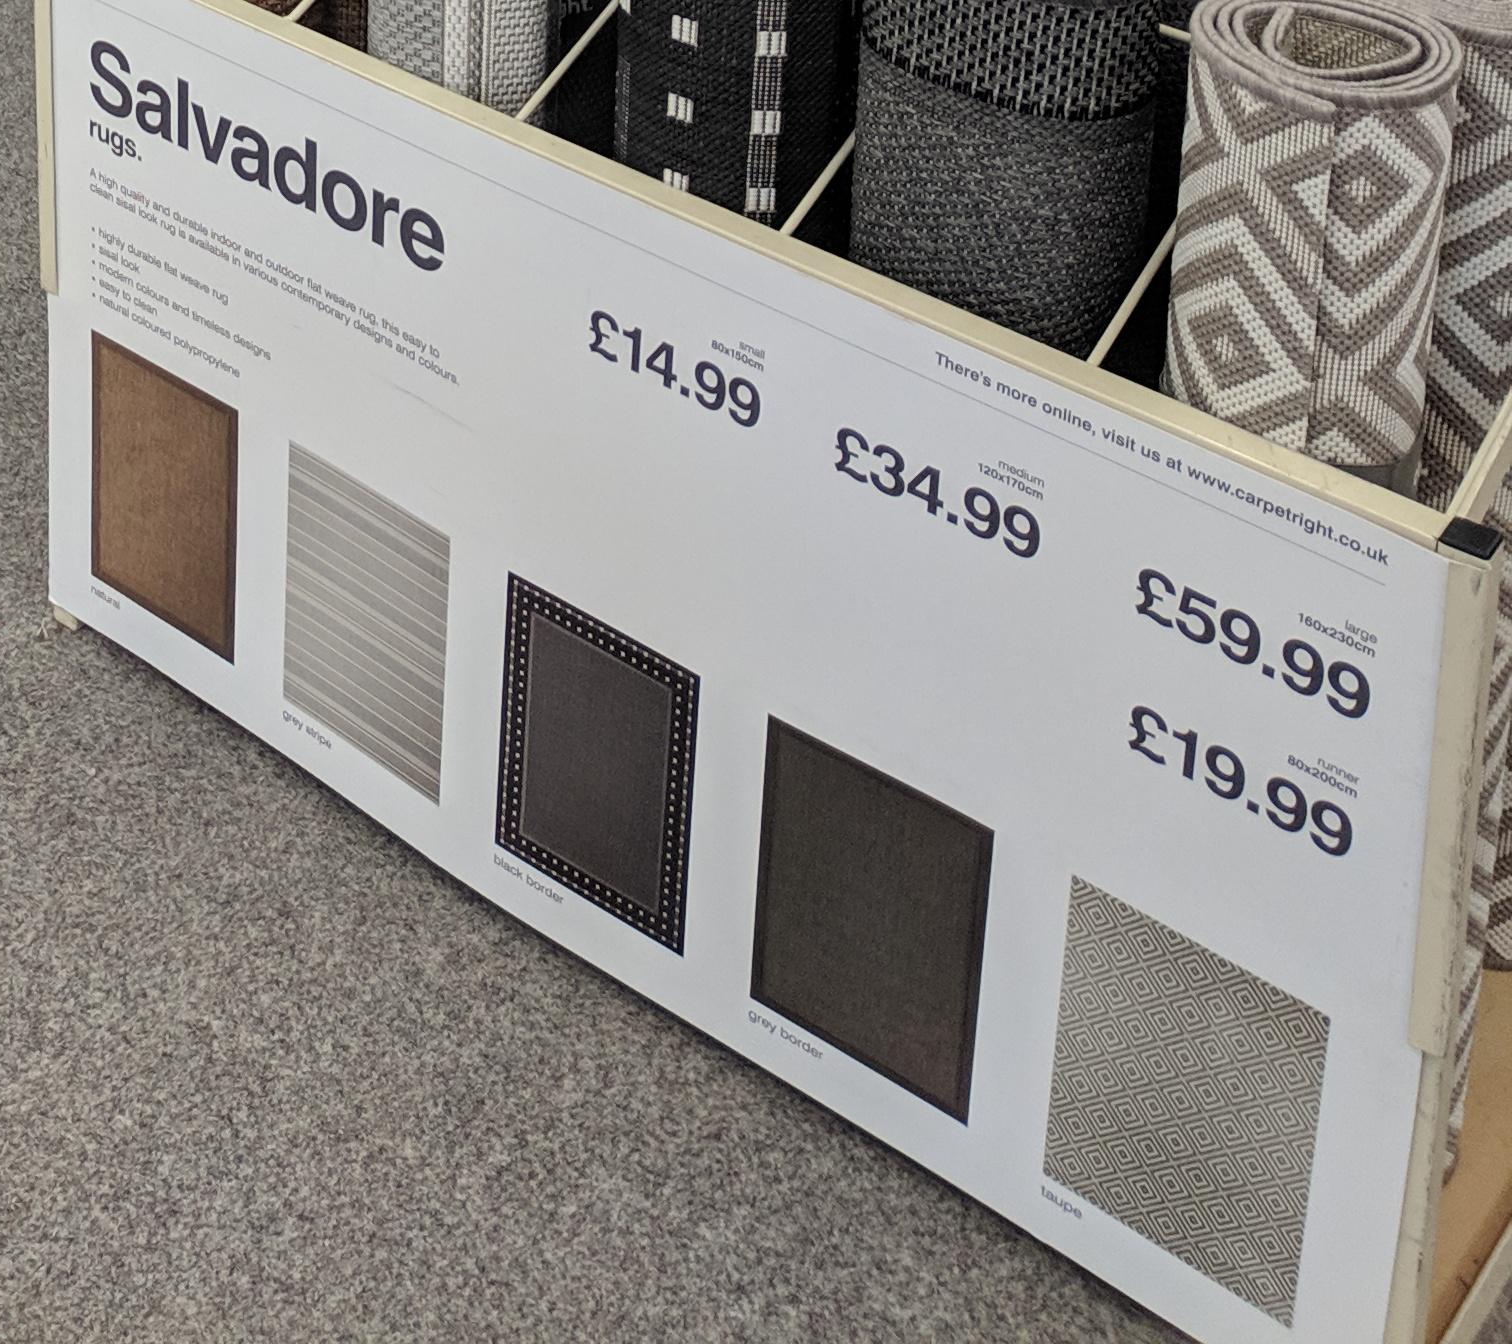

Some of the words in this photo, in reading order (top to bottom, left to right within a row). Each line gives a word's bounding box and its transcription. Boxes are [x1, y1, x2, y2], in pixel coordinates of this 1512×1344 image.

[89, 119, 142, 162] rugs.
[89, 40, 446, 272] Salvadore
[89, 167, 97, 179] A
[99, 172, 119, 190] high
[120, 185, 150, 208] quality
[152, 202, 170, 217] and
[173, 207, 209, 236] durable
[210, 229, 242, 252] indoor
[243, 248, 264, 265] and
[266, 255, 304, 286] outdoor
[307, 278, 322, 294] flat
[324, 288, 357, 313] weave
[381, 317, 400, 336] this
[402, 331, 427, 353] easy
[429, 345, 440, 358] to
[90, 183, 114, 202] clean
[115, 197, 136, 213] sisal
[138, 207, 158, 225] look
[160, 220, 176, 237] rug
[178, 227, 186, 239] is
[188, 234, 230, 262] available
[232, 254, 241, 268] in
[243, 262, 279, 287] various
[281, 281, 351, 326] contemporary
[353, 319, 393, 348] designs
[396, 343, 415, 360] and
[98, 227, 125, 251] highly
[127, 243, 162, 269] durable
[180, 272, 210, 294] weave
[212, 289, 228, 306] rug
[121, 255, 140, 274] look
[99, 279, 120, 297] easy
[122, 289, 132, 301] to
[134, 296, 158, 316] clean
[99, 262, 134, 287] modern
[136, 280, 169, 306] colours
[172, 301, 190, 317] and
[233, 333, 271, 360] designs
[99, 295, 130, 318] natural
[131, 312, 171, 340] coloured
[174, 335, 240, 378] polypropylene
[711, 339, 764, 373] 80x150cm
[738, 340, 766, 360] small
[589, 310, 762, 428] £14.99
[935, 351, 992, 389] There's
[996, 381, 1038, 410] more
[1041, 399, 1097, 438] online,
[1102, 427, 1137, 453] visit
[1141, 443, 1161, 463] us
[1166, 453, 1183, 473] at
[1188, 464, 1389, 567] www.carpetright.co.uk
[977, 462, 1045, 502] 120x170cm
[997, 459, 1045, 489] medium
[835, 427, 1041, 558] £34.99
[1135, 568, 1371, 719] £59.99
[1297, 613, 1376, 658] 160x230cm
[1344, 619, 1378, 645] large
[1128, 705, 1353, 857] £19.99
[1288, 754, 1358, 799] 80x200cm
[1317, 757, 1360, 787] runner
[494, 853, 523, 880] black
[526, 874, 564, 904] border
[748, 1010, 778, 1036] grey
[779, 1027, 824, 1061] border
[1040, 1185, 1083, 1219] taupe
